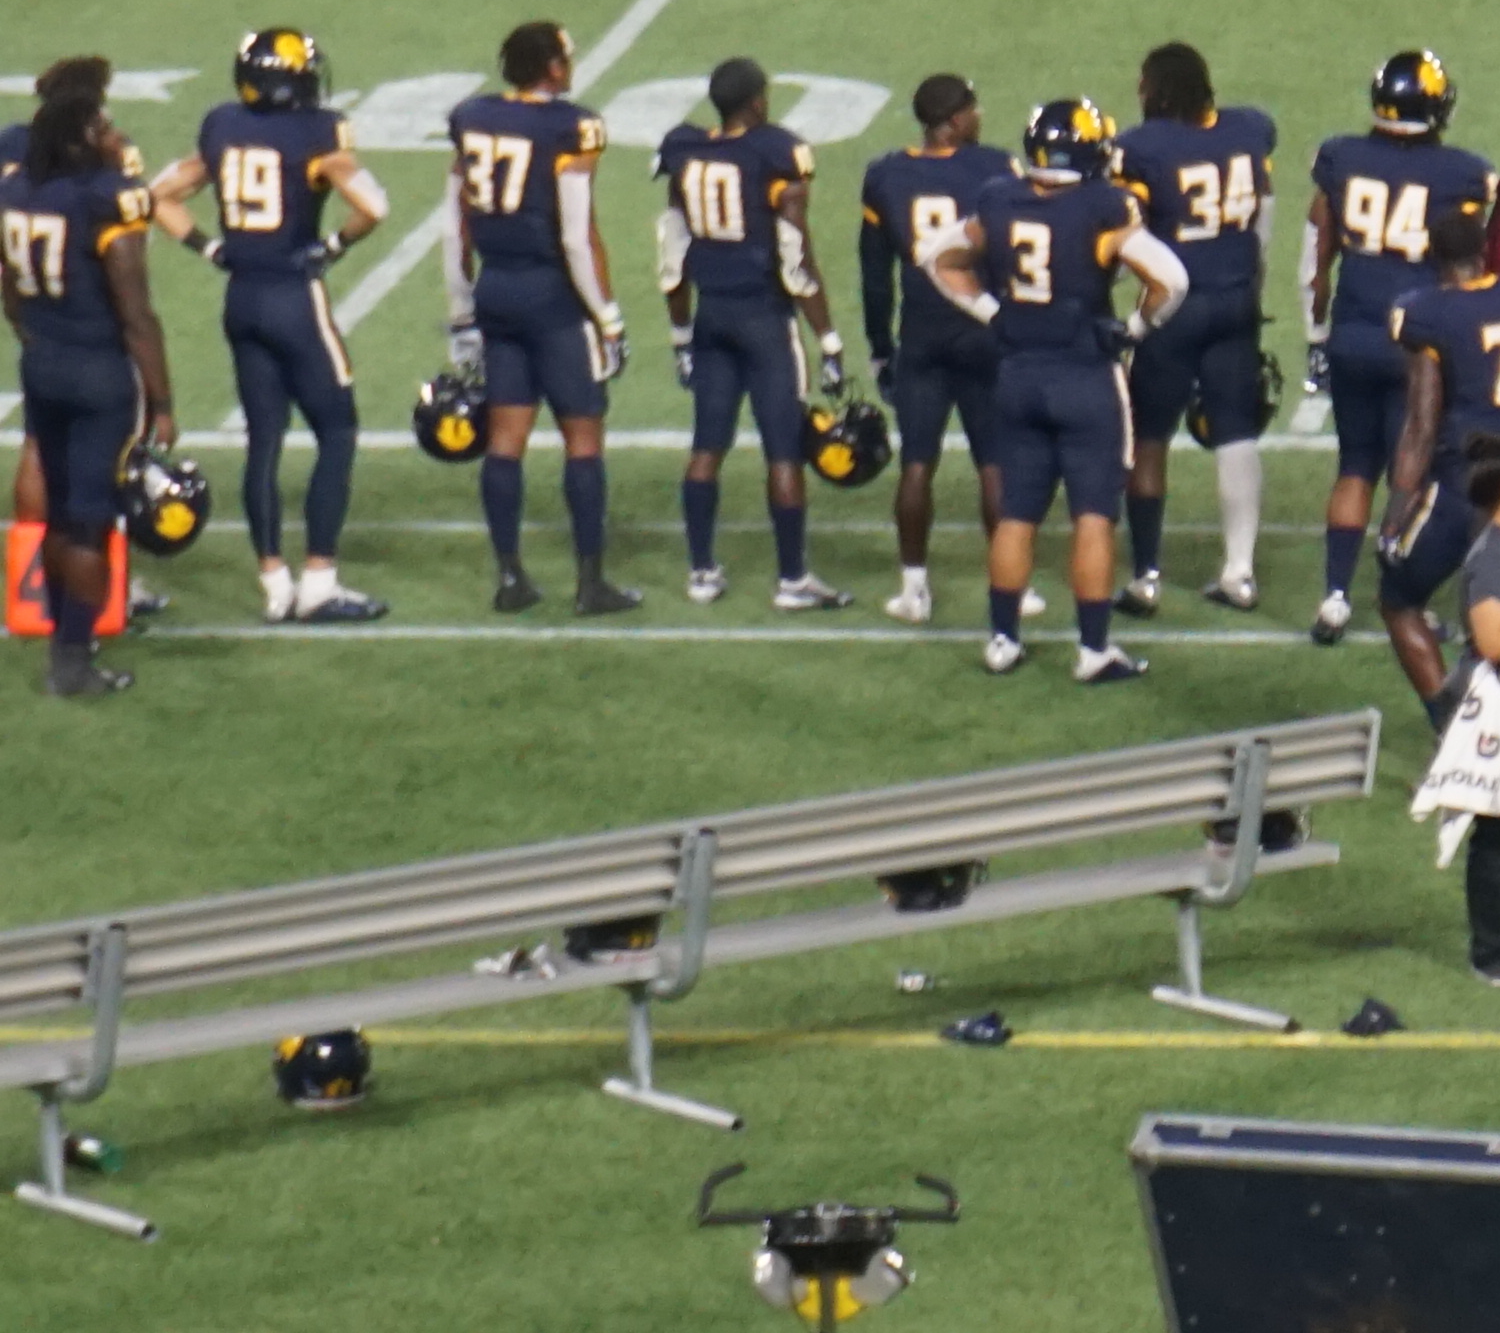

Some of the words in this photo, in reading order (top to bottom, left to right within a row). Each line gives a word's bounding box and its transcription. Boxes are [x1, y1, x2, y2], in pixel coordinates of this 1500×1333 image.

[220, 146, 283, 231] 19
[461, 132, 532, 214] 37
[681, 158, 746, 242] 10
[1176, 154, 1258, 243] 34
[2, 210, 67, 299] 97
[1009, 220, 1053, 305] 3
[1342, 176, 1430, 264] 94
